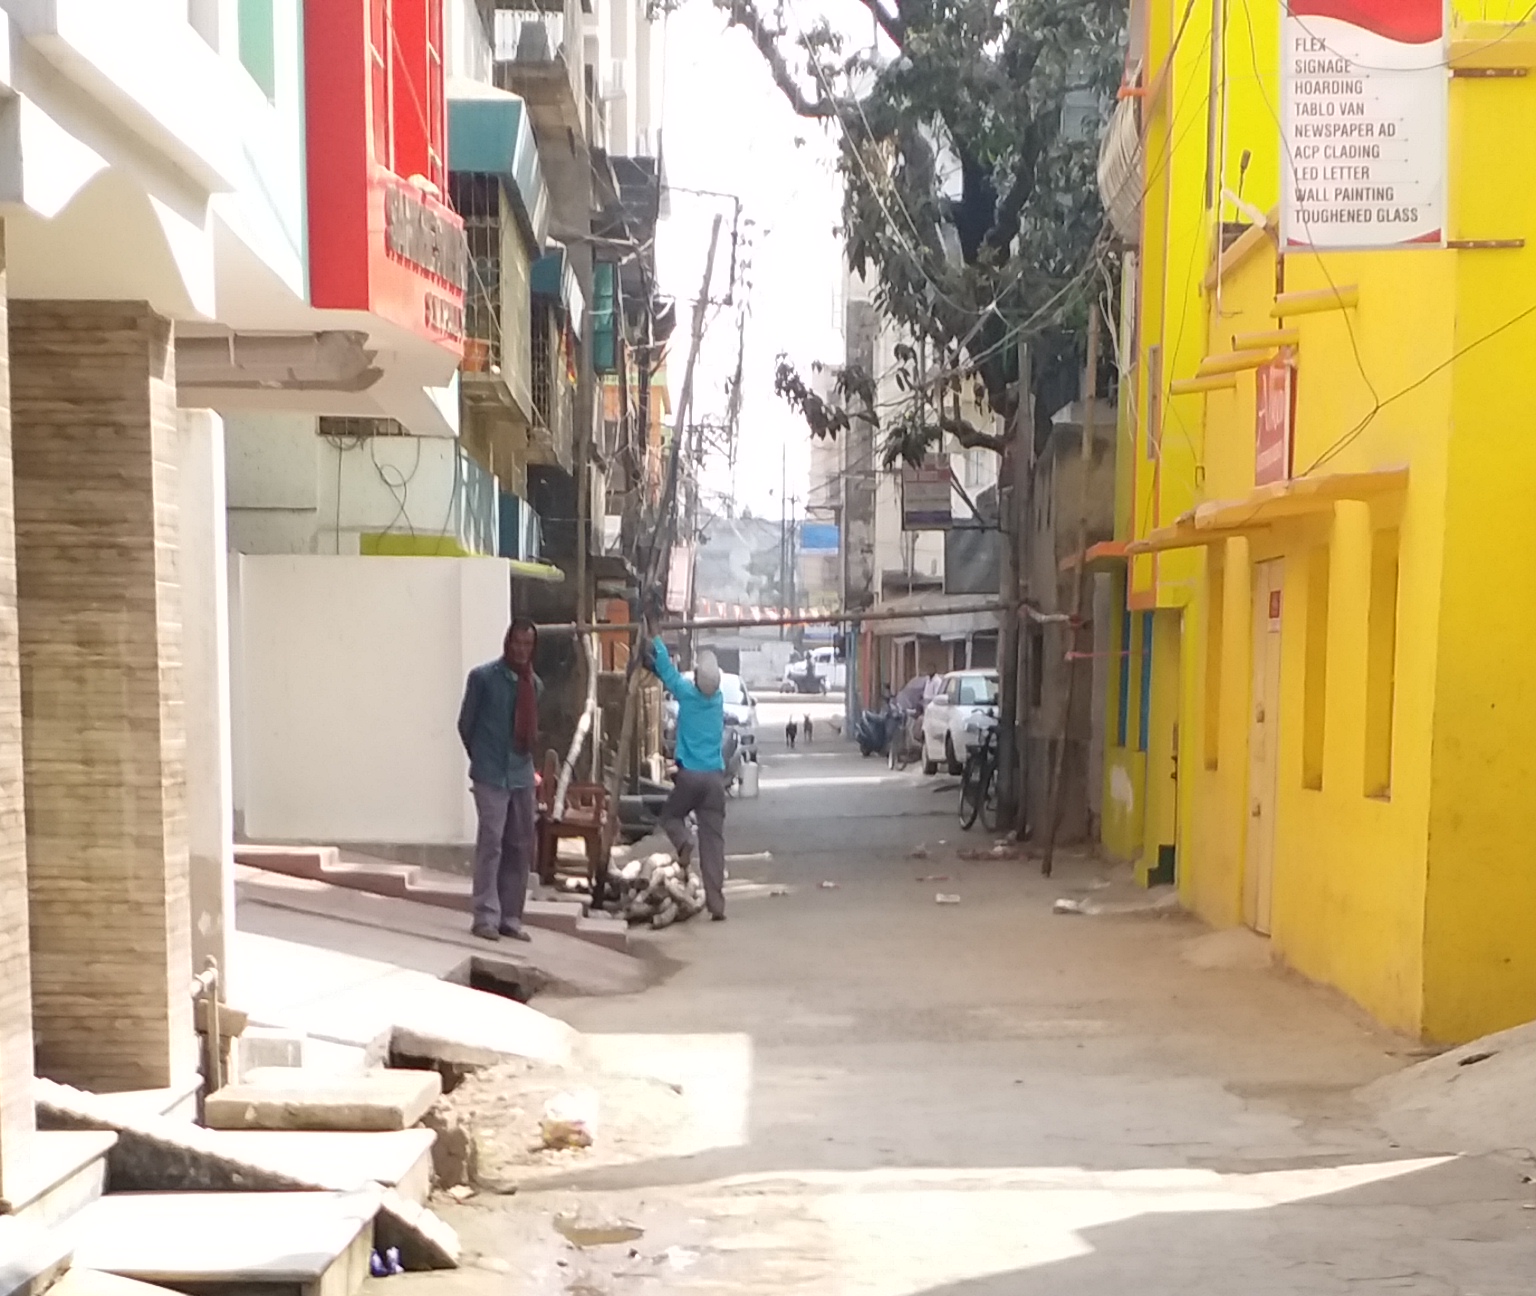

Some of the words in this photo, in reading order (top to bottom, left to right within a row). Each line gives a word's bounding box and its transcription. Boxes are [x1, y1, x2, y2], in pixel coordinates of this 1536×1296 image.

[1295, 38, 1326, 52] FLEX
[1295, 58, 1351, 74] SIGNAGE
[1295, 80, 1363, 94] HOARDING
[1295, 102, 1334, 116] TABLO
[1339, 102, 1364, 116] VAN
[1295, 123, 1374, 138] NEWSPAPER
[1378, 122, 1396, 137] AD
[1294, 145, 1320, 159] ACP
[1324, 144, 1380, 159] CLADING
[1295, 166, 1318, 181] LED
[1323, 165, 1370, 180] LETTER
[1294, 187, 1330, 202] WALL
[1334, 186, 1394, 201] PAINTING
[1294, 208, 1372, 224] TOUGHENED
[1376, 207, 1419, 223] GLASS
